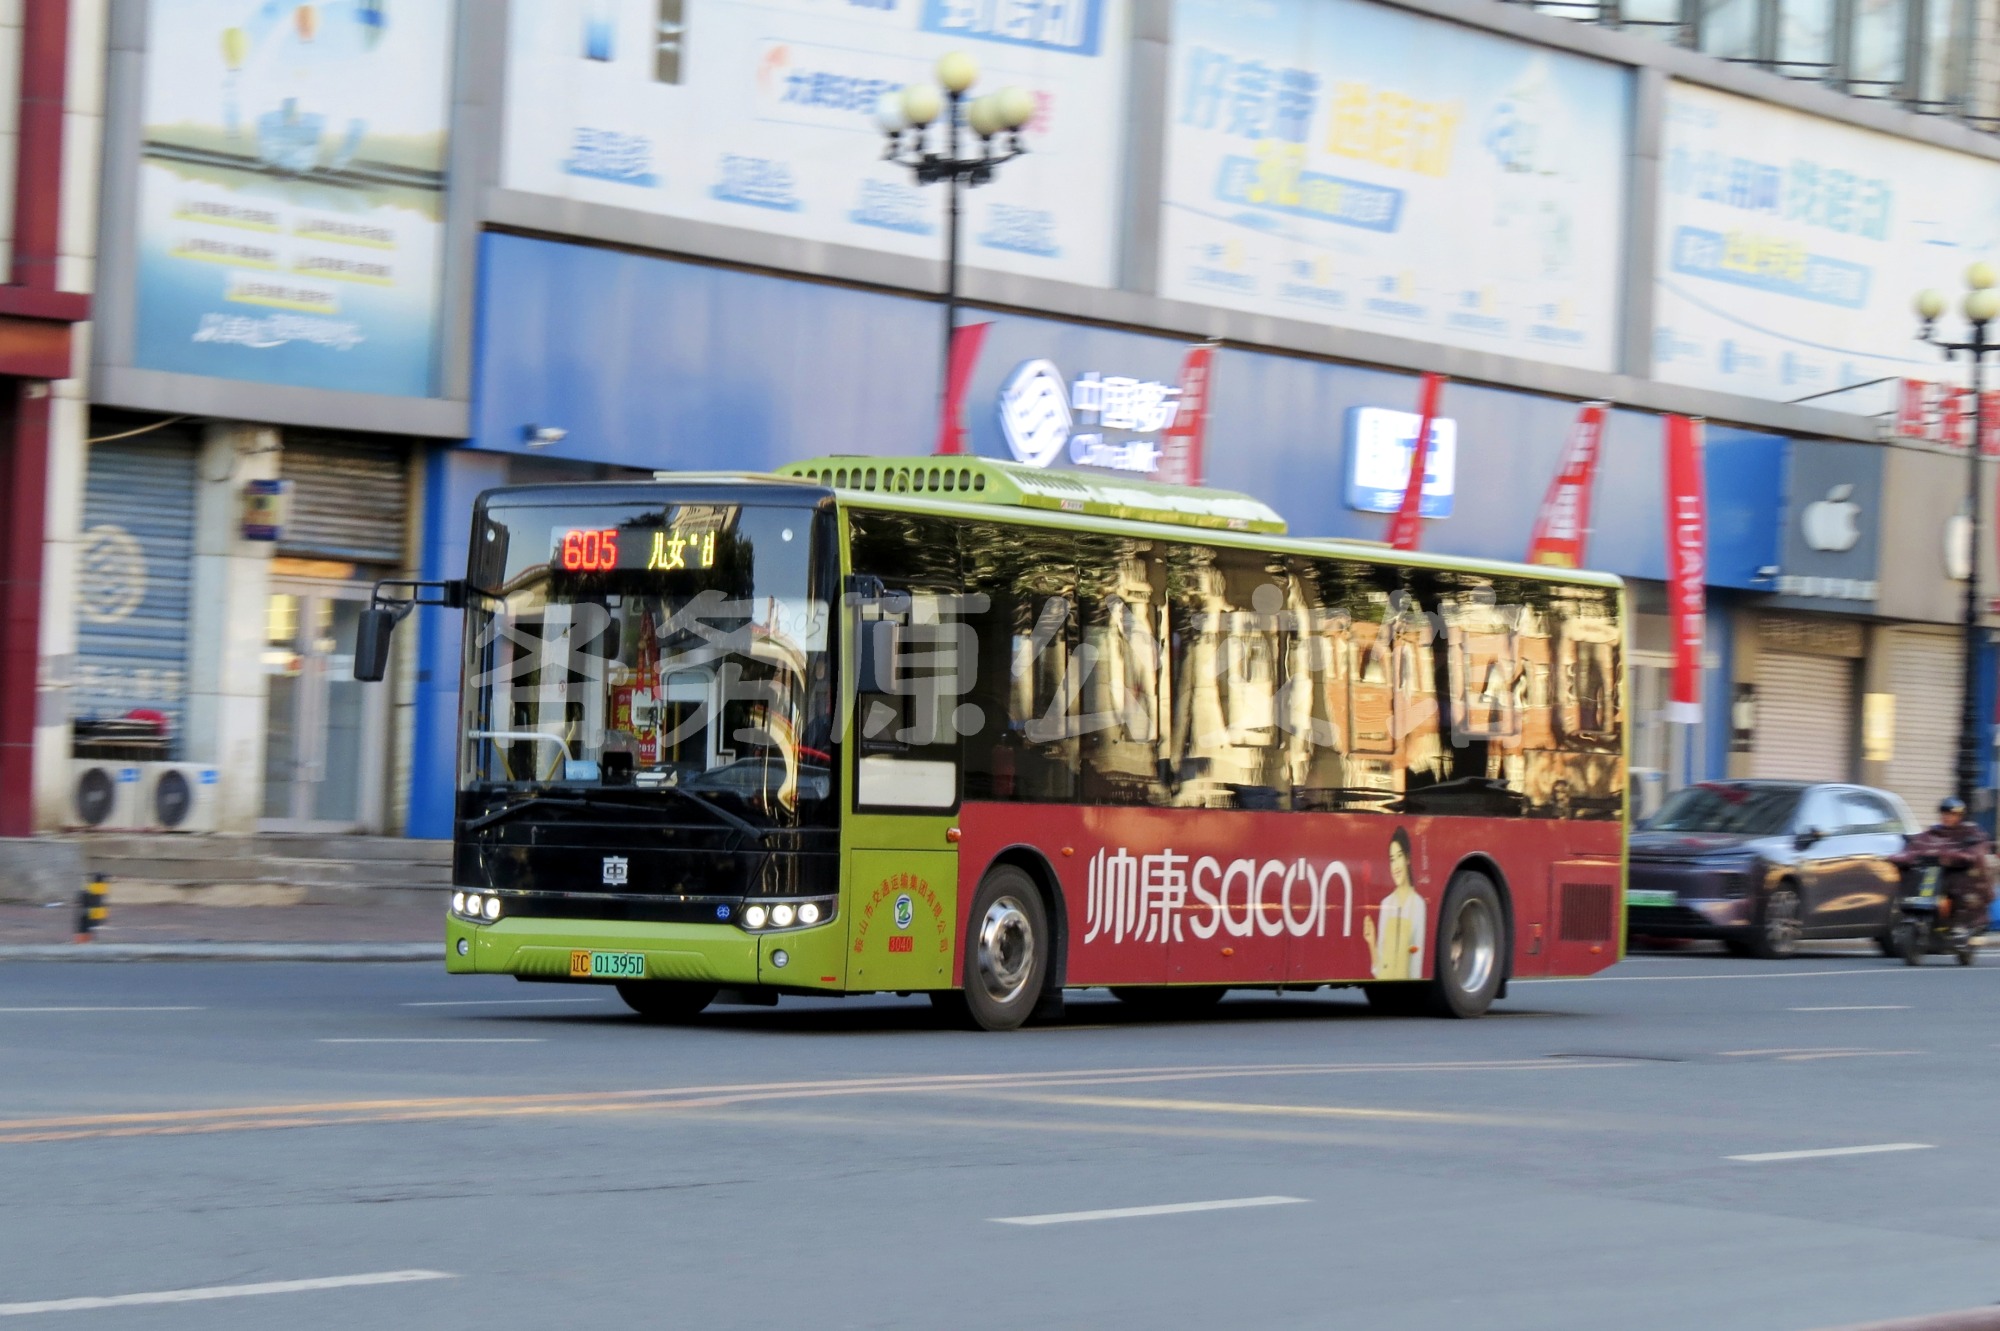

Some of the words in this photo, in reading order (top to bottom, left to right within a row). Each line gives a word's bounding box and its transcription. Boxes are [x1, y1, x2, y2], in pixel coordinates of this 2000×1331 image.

[564, 530, 618, 570] 605
[853, 871, 949, 954] 鞍山市交通运输集团有限公司
[1189, 855, 1353, 940] sacon
[889, 937, 913, 952] 3040
